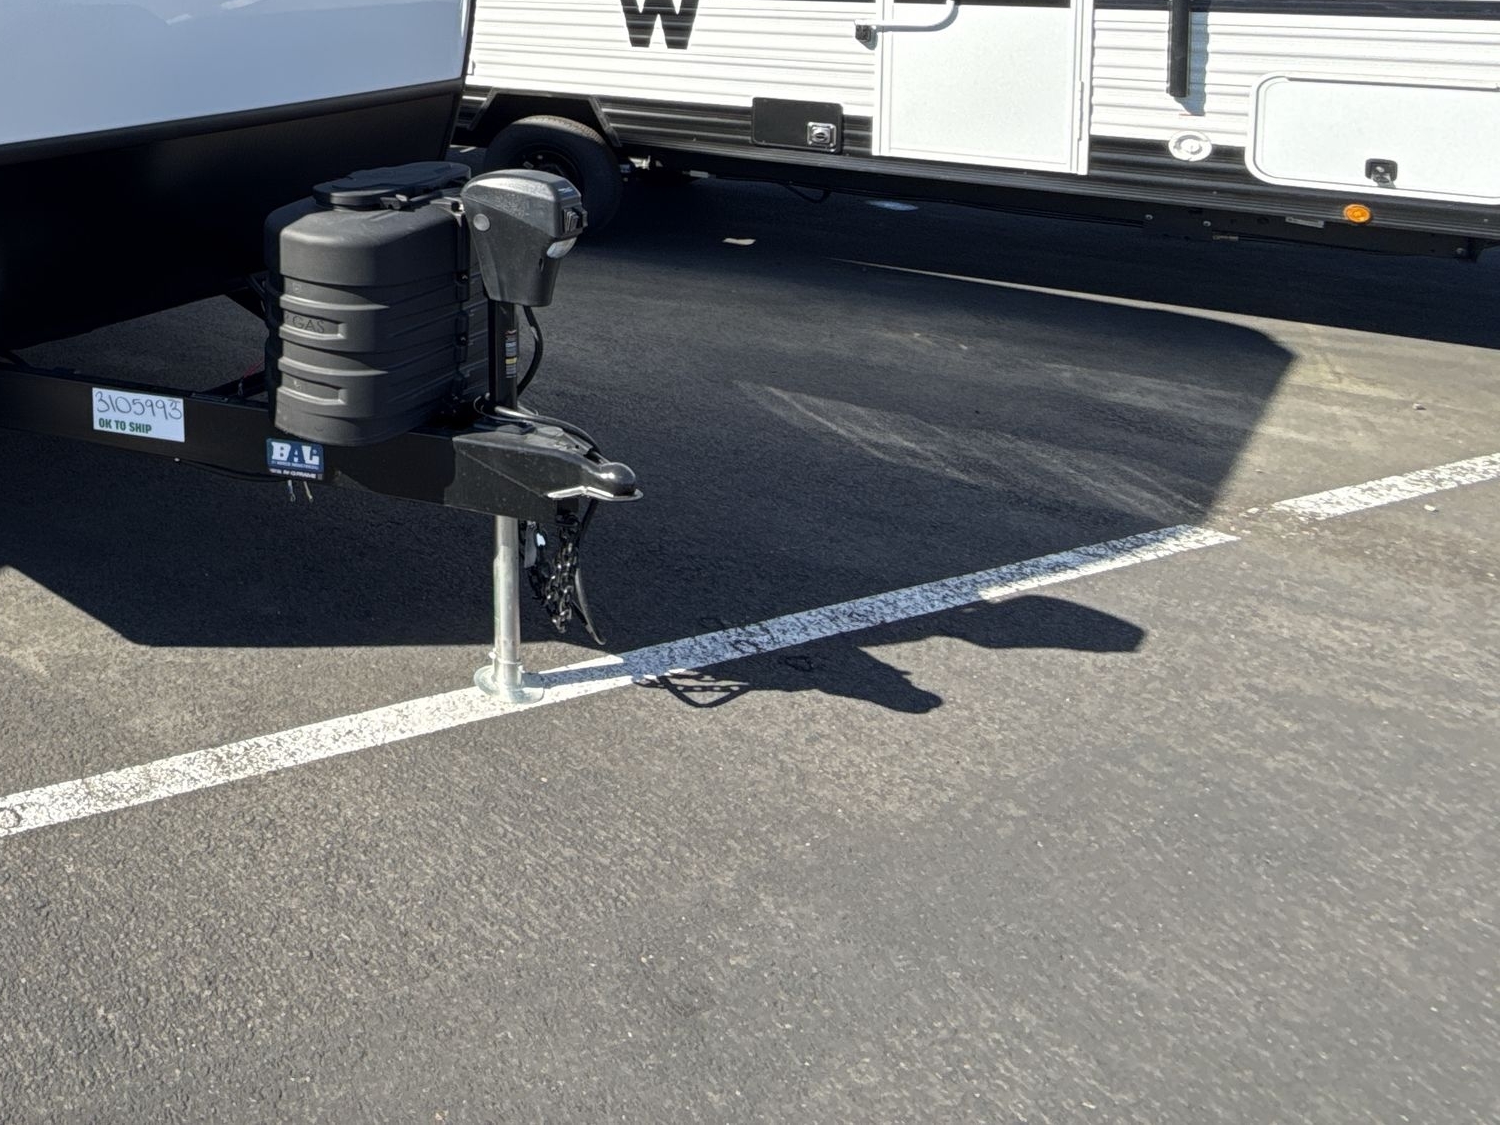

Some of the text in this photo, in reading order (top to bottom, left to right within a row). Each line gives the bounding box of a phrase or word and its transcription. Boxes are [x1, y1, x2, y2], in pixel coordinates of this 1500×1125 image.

[98, 418, 152, 434] OK TO SHIP
[271, 441, 320, 465] BAL
